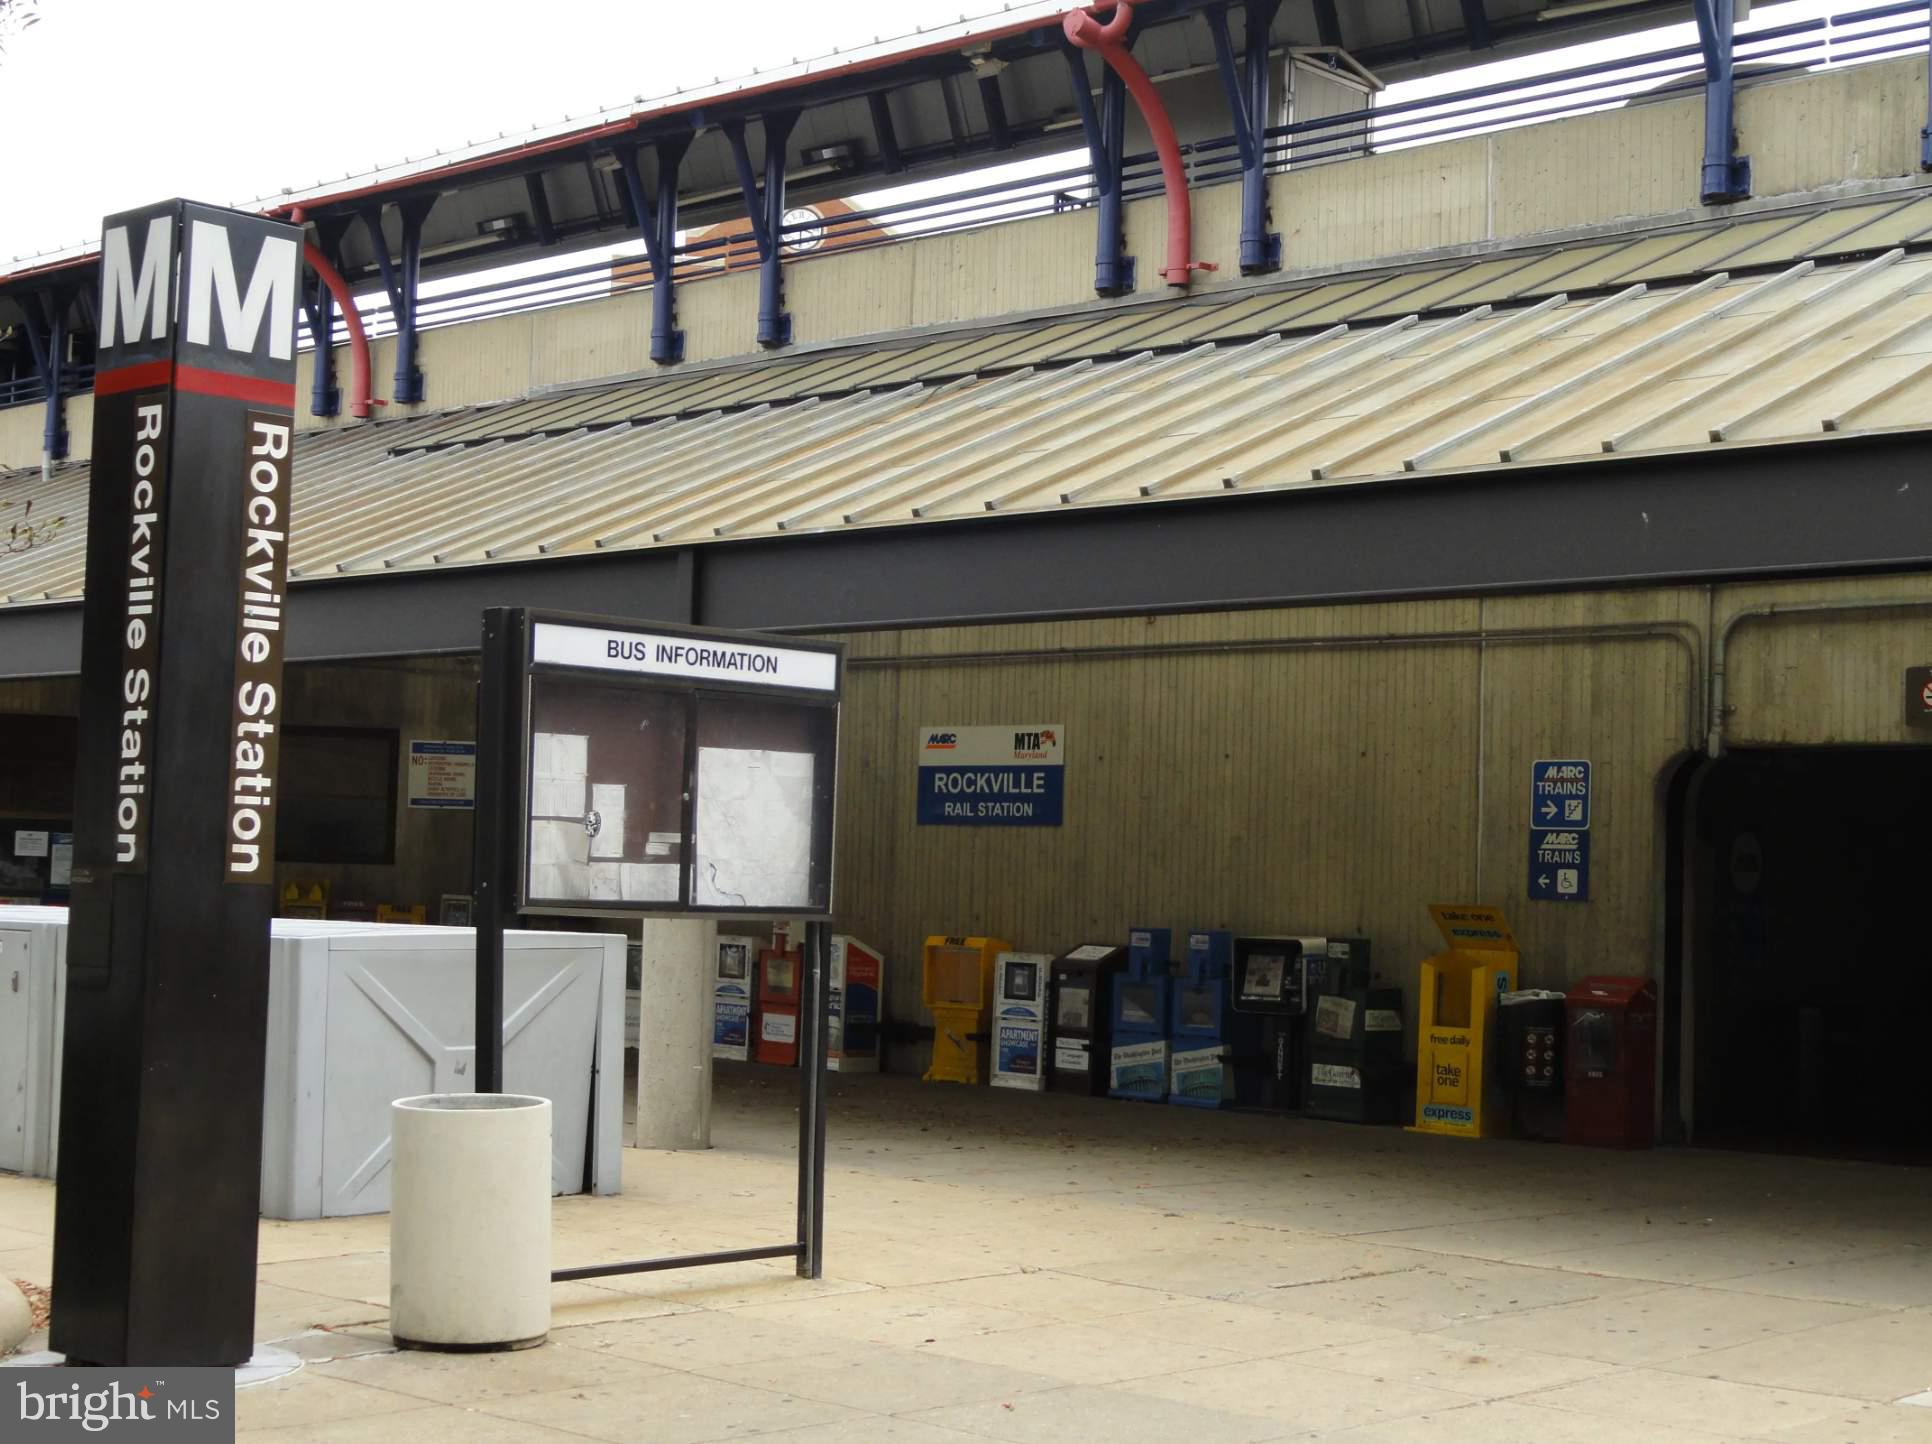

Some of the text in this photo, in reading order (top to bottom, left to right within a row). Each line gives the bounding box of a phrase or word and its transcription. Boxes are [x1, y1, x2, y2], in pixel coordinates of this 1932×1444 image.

[99, 216, 172, 349] M
[187, 220, 297, 360] M
[116, 404, 162, 862] Rockville Station
[230, 421, 289, 872] Rockville Station
[607, 639, 778, 673] BUS INFORMATION
[1014, 732, 1040, 750] MTA
[1544, 766, 1585, 778] MARC
[934, 772, 1045, 793] ROCKVILLE
[1537, 782, 1586, 795] TRAINS
[944, 802, 1033, 816] RAIL STATION
[1543, 832, 1579, 844] MARC
[1537, 850, 1581, 864] TRAINS
[1470, 912, 1495, 922] one
[1451, 928, 1502, 939] express
[1001, 1028, 1038, 1041] APARTMENT
[1430, 1033, 1470, 1047] free daily
[1436, 1063, 1461, 1077] take
[1437, 1075, 1459, 1087] one
[1423, 1106, 1471, 1121] express
